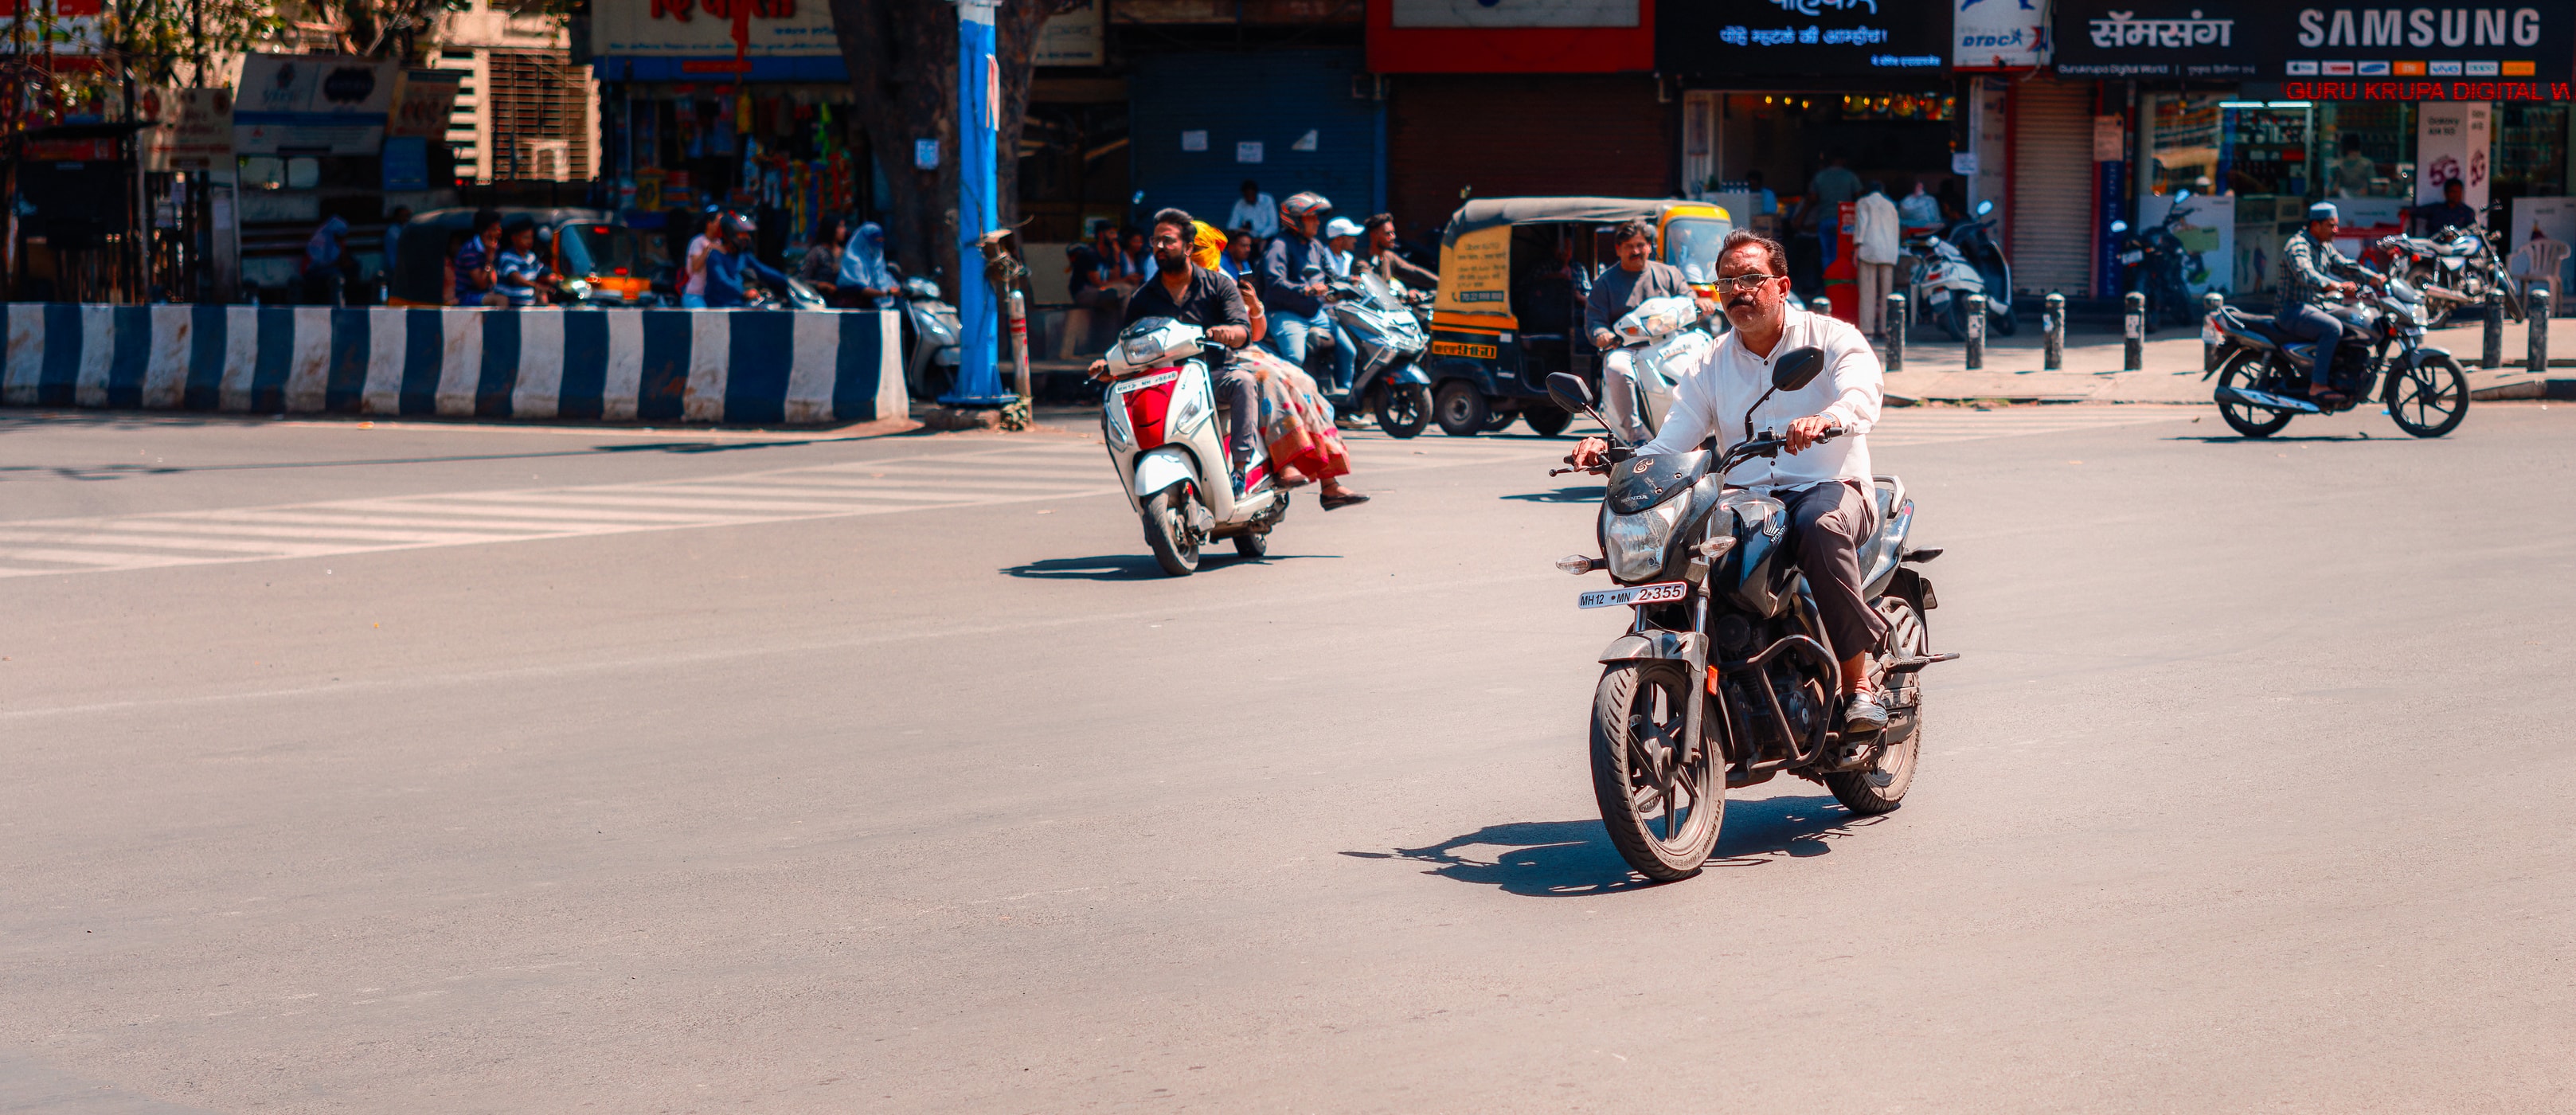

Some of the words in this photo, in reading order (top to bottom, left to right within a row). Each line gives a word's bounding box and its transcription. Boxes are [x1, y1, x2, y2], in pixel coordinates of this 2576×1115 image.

[2089, 10, 2234, 48] सॅमसंग
[2298, 8, 2540, 47] SAMSUNG
[1962, 35, 2011, 47] DTDC
[2286, 82, 2357, 100] GURU
[2364, 82, 2445, 100] KRUPA
[2453, 82, 2544, 100] DIGITAL
[1580, 594, 1605, 606] MH12
[1616, 592, 1631, 604] MN
[1640, 585, 1682, 601] 2355
